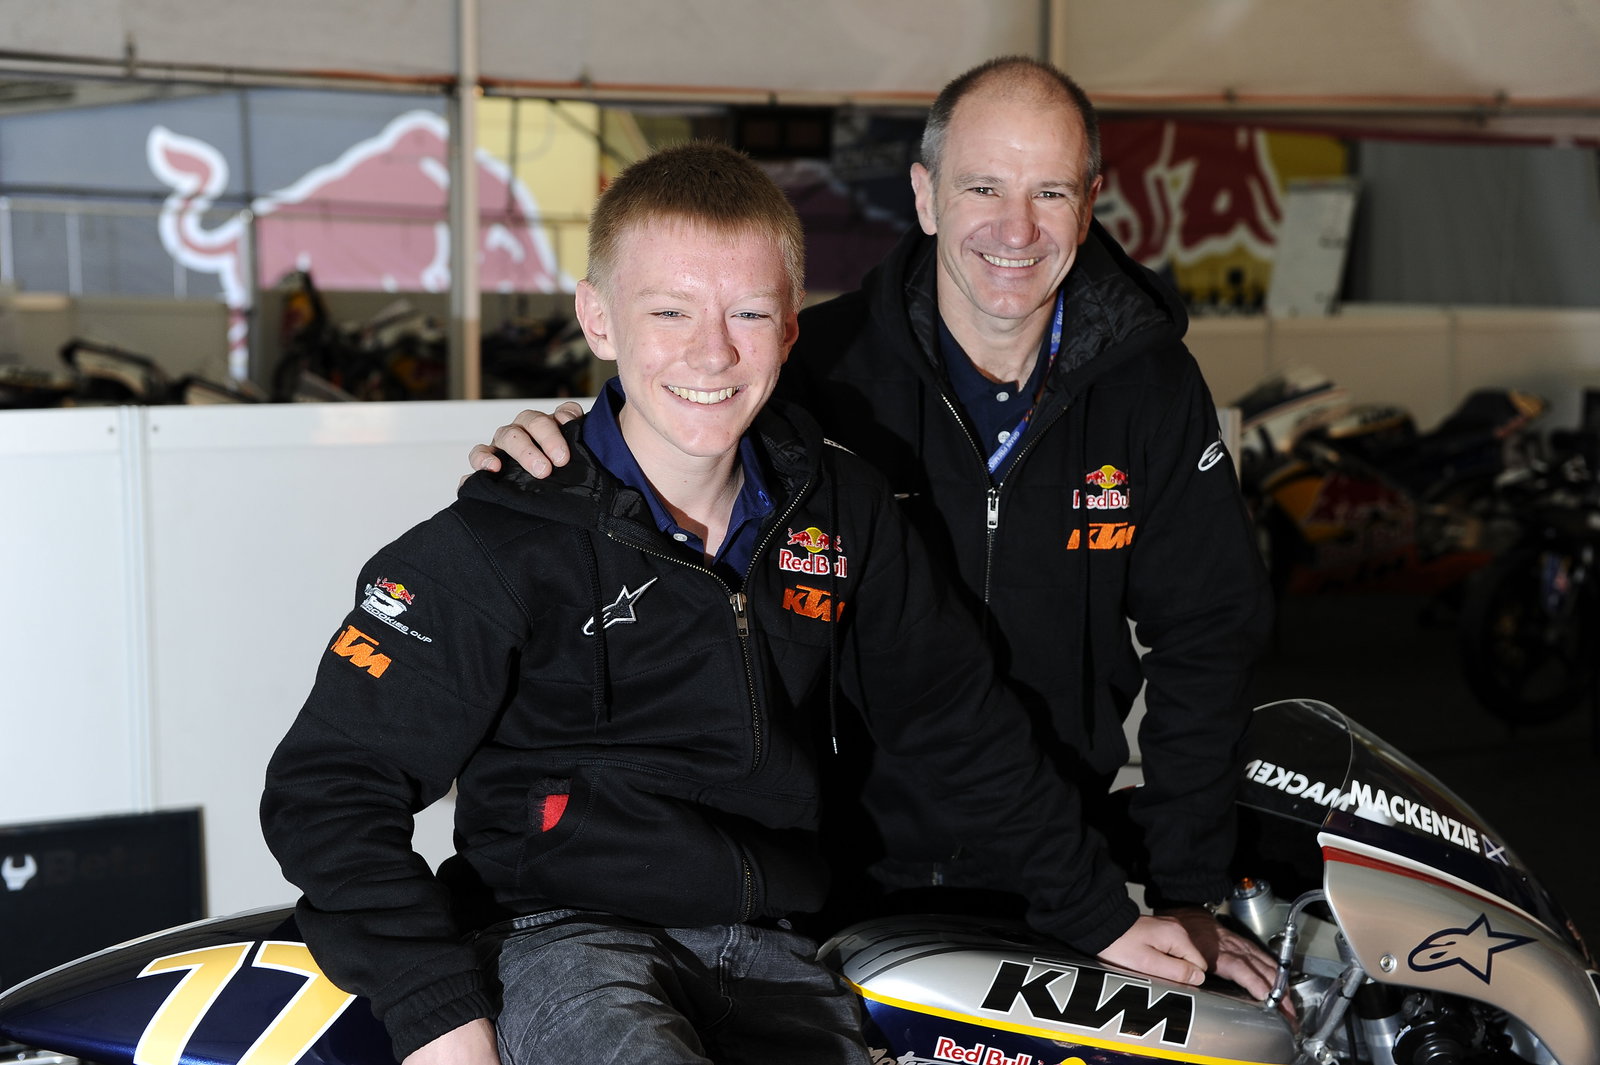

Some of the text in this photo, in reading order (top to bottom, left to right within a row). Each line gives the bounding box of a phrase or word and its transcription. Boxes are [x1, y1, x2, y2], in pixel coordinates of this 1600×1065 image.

[779, 548, 815, 574] Red
[365, 603, 433, 643] ROOKIES CUP
[782, 584, 846, 623] KTM
[330, 625, 393, 679] TM
[1349, 779, 1481, 854] MACKENZIE
[133, 940, 358, 1065] 77
[980, 957, 1196, 1049] KTM
[933, 1035, 986, 1065] Red
